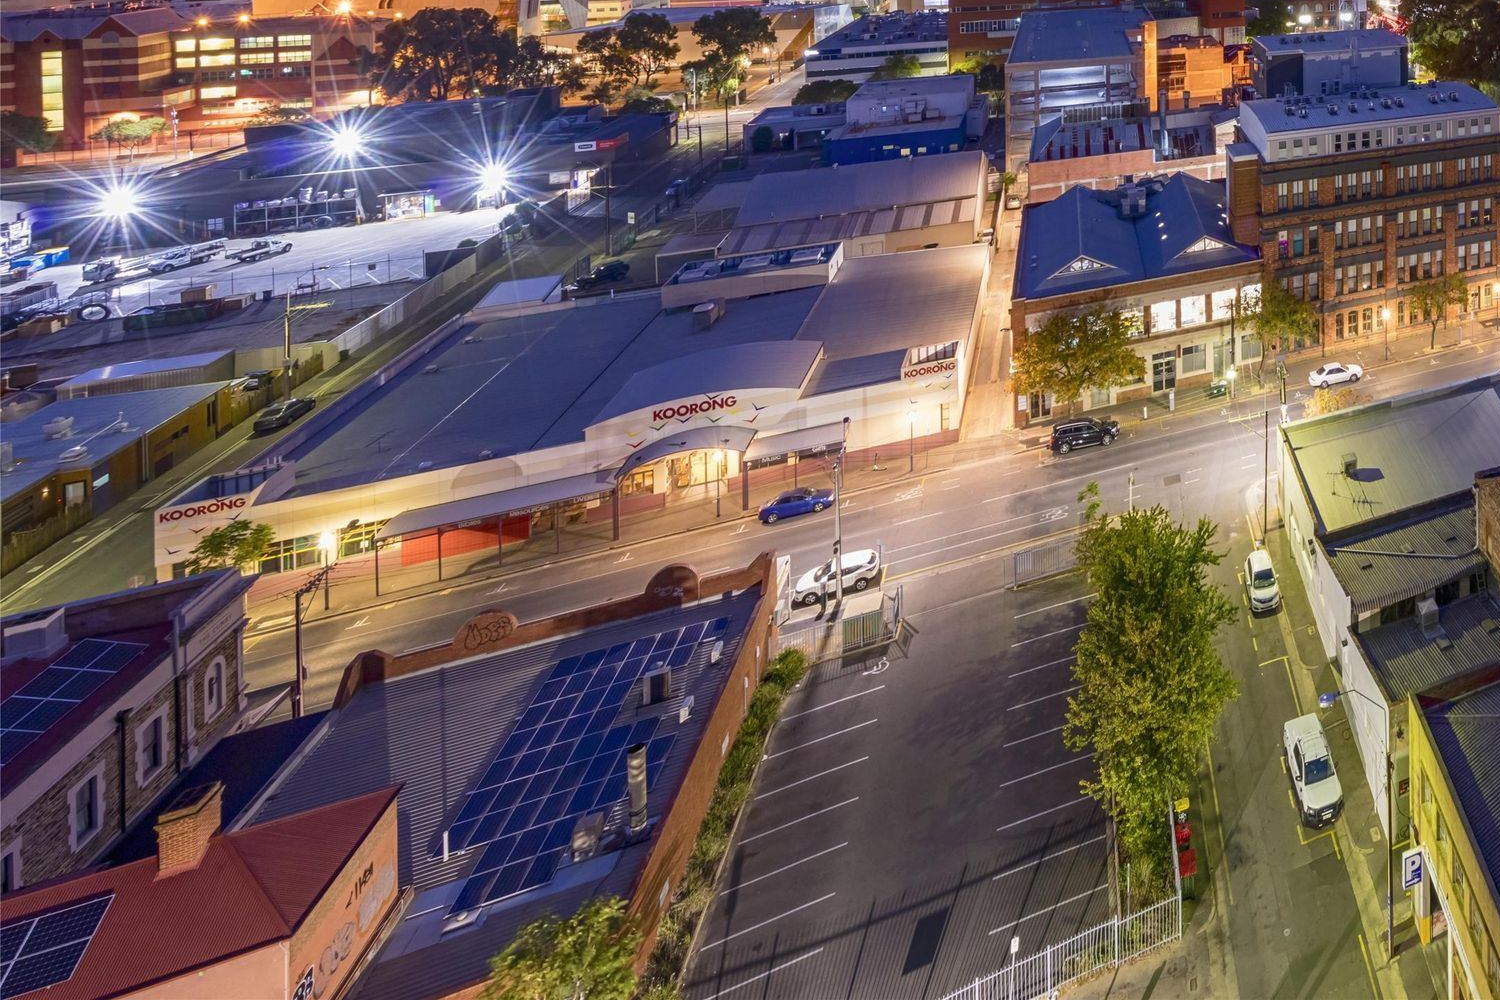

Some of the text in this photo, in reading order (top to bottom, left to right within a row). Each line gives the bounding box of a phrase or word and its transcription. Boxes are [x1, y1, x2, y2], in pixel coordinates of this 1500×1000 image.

[904, 362, 956, 379] KOORONG
[653, 395, 737, 422] KOORONG
[159, 497, 246, 523] KOORONG
[1405, 854, 1421, 882] P
